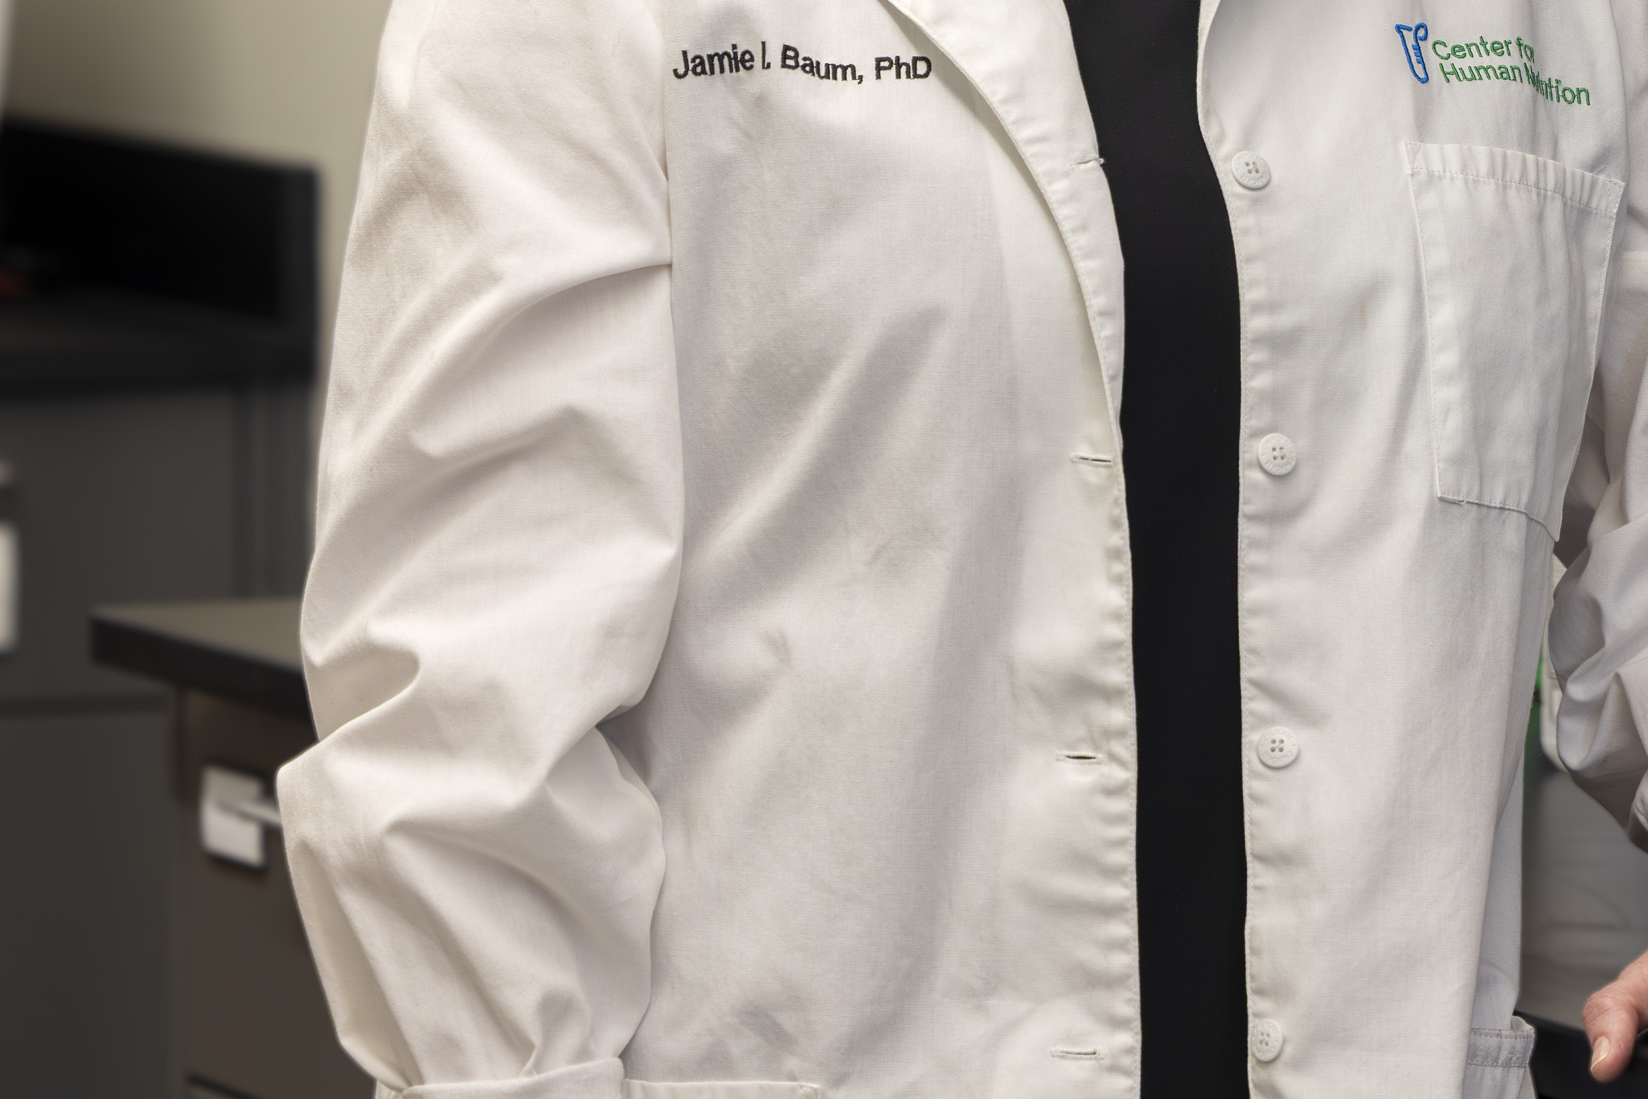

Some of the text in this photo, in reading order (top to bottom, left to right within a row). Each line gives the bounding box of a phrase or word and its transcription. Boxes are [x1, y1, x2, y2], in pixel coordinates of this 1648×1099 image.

[1431, 36, 1513, 61] Center
[672, 43, 755, 81] Jamie
[780, 44, 864, 85] Baum,
[874, 55, 932, 81] PhD
[1439, 61, 1523, 84] Human
